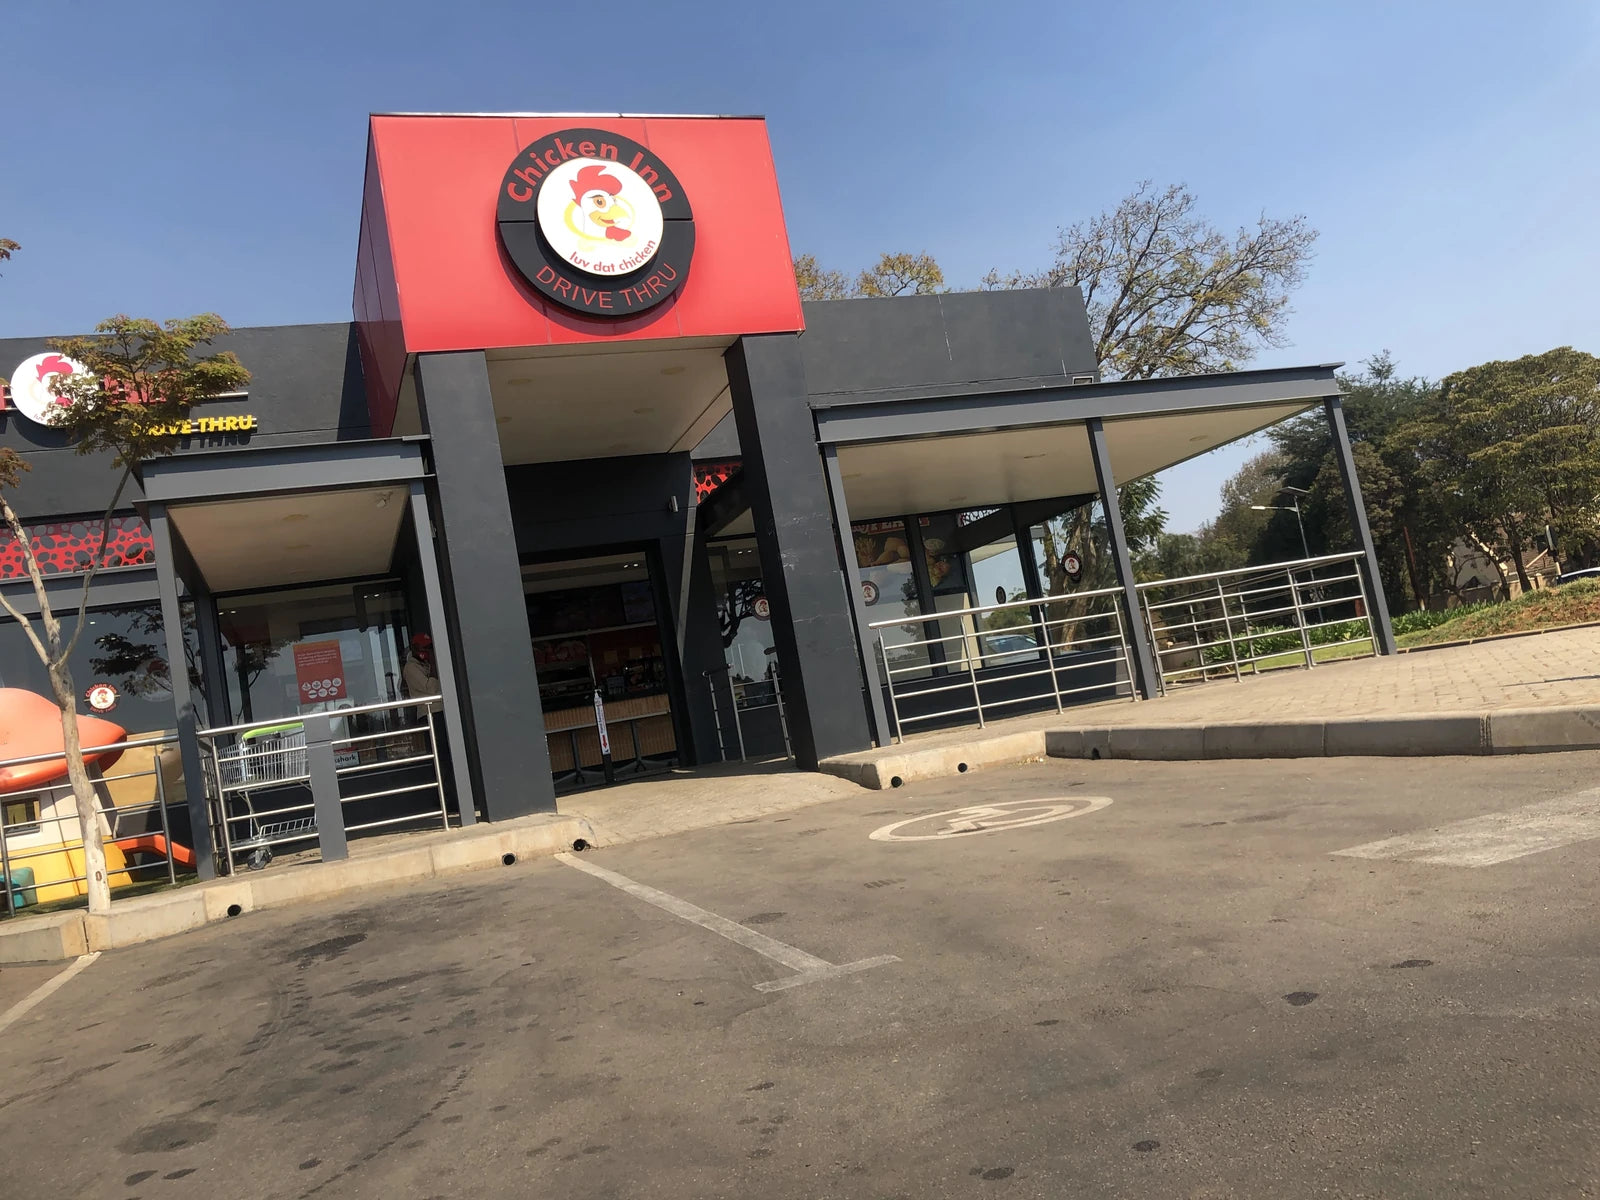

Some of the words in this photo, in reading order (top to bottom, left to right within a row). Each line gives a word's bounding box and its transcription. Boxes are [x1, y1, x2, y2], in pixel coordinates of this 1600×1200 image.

[507, 137, 619, 203] Chicken
[629, 151, 673, 204] Inn
[569, 251, 590, 268] luv
[593, 261, 616, 273] dat
[618, 239, 656, 271] chicken
[536, 265, 614, 309] DRIVE
[619, 262, 677, 306] THRU
[198, 414, 253, 433] THRU
